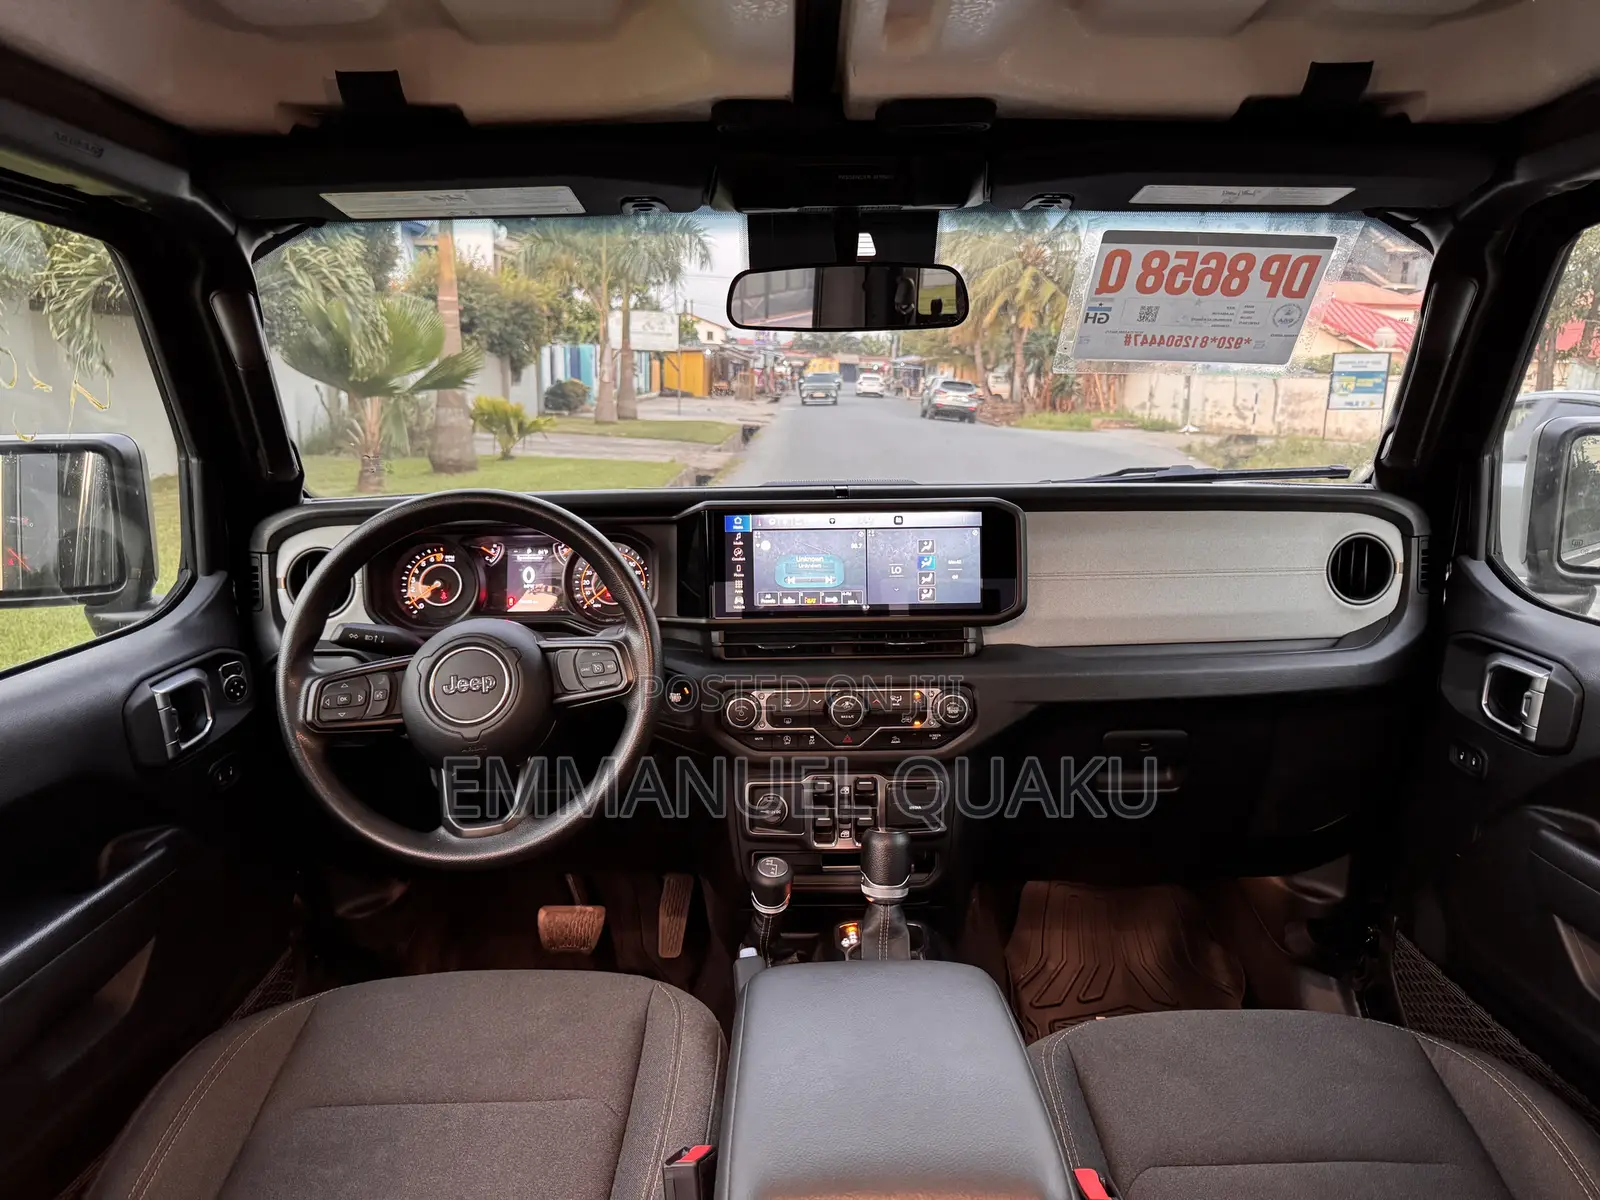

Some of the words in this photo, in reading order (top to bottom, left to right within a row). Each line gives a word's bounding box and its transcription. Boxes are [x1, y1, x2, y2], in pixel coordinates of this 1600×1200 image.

[796, 556, 824, 564] Unknown
[891, 566, 902, 575] LO
[442, 675, 497, 695] Jeep
